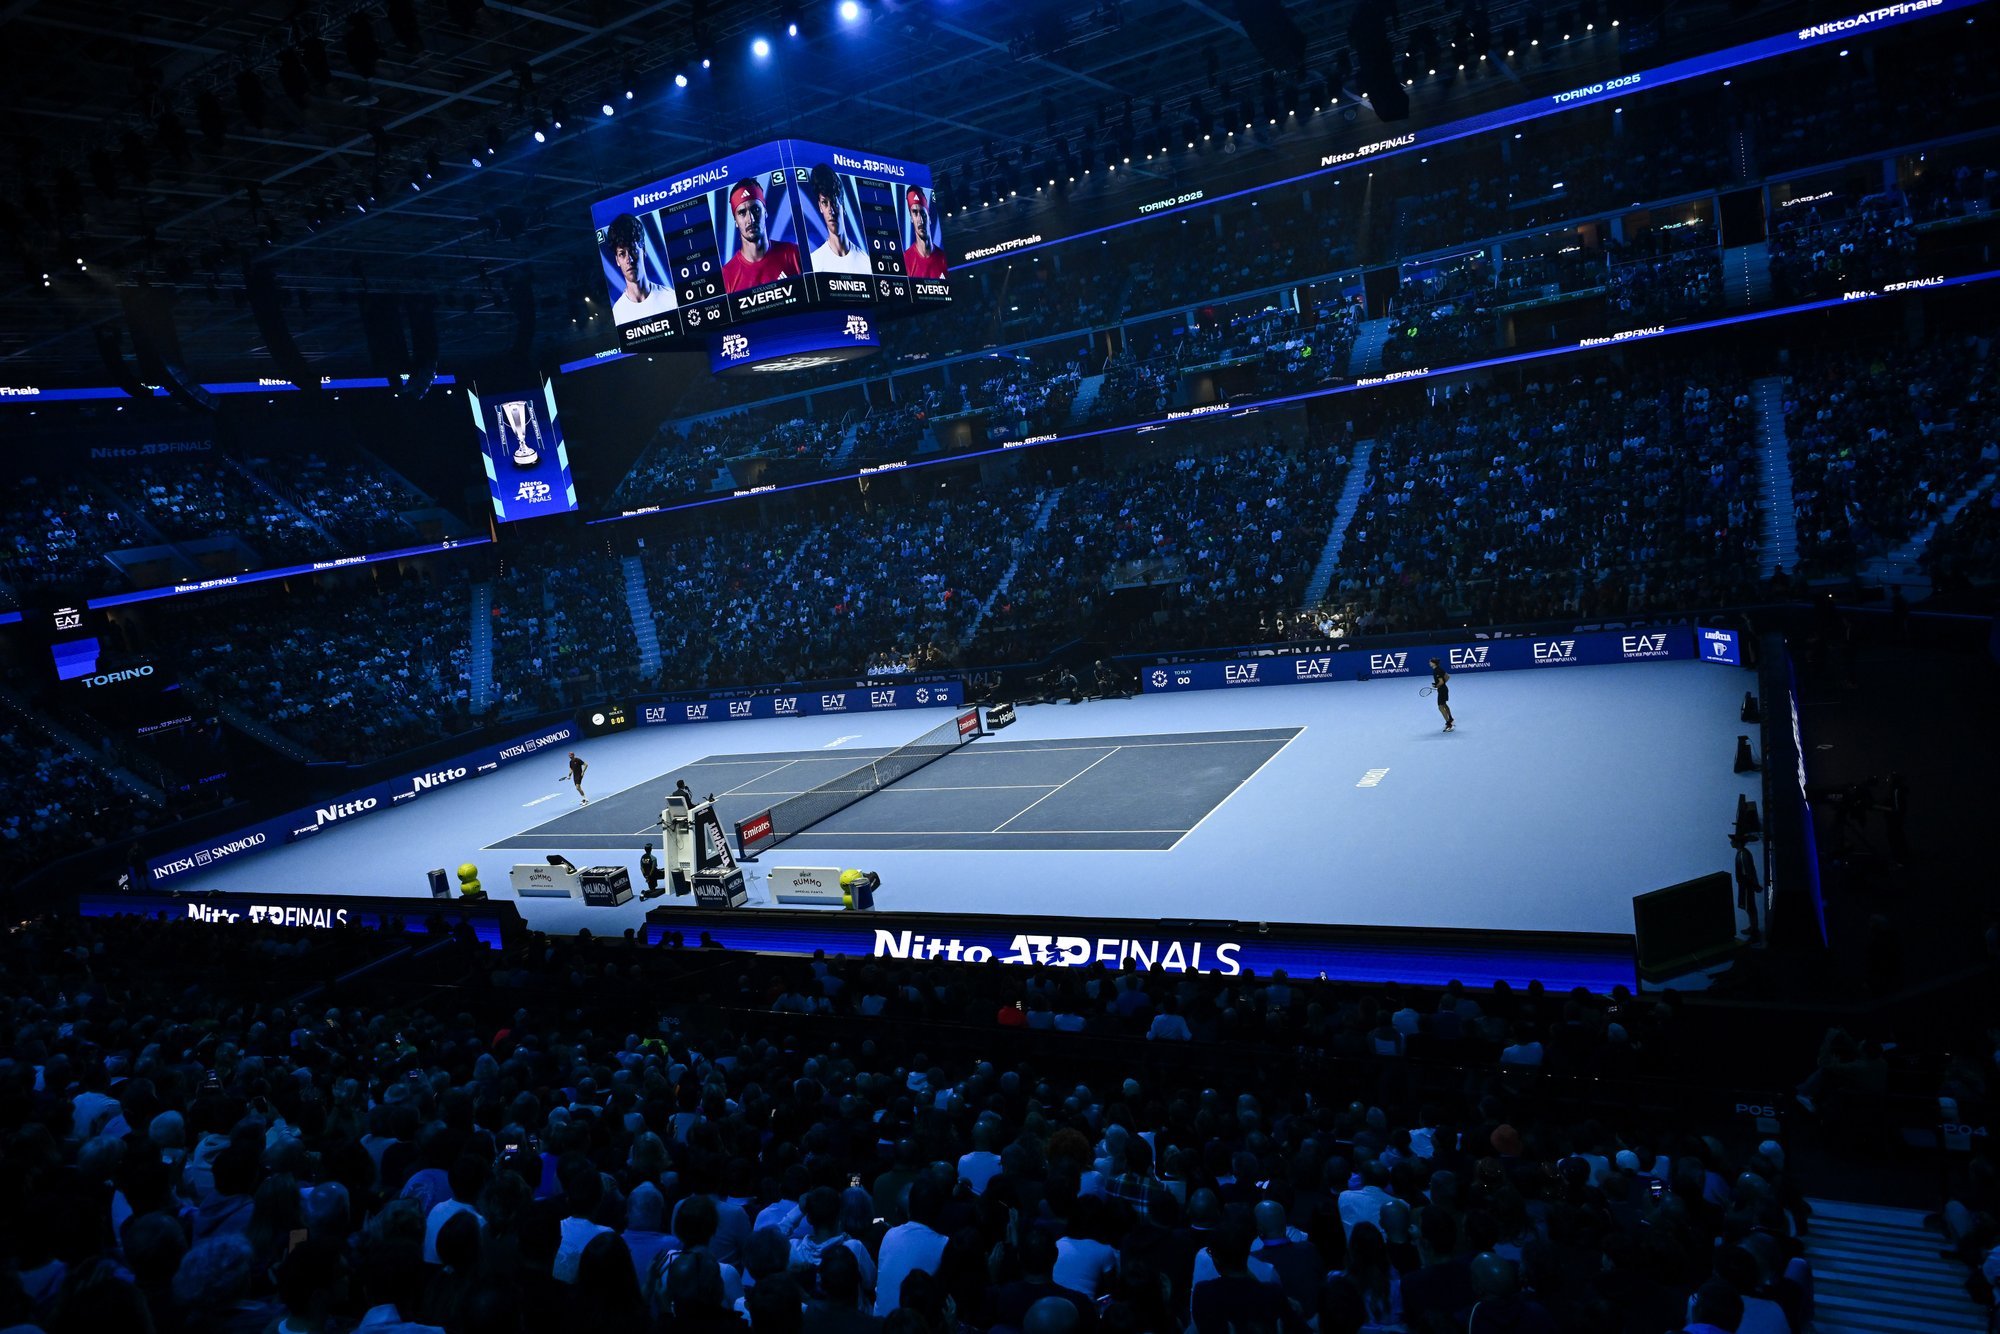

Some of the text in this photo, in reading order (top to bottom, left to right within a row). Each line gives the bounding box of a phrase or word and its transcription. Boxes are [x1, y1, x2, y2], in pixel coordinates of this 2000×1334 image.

[1798, 0, 1943, 40] #NittoATPFinals
[1552, 74, 1641, 104] TORINO 2025
[833, 153, 861, 169] Nitto
[1321, 153, 1355, 166] Nitto
[773, 171, 784, 183] 3
[797, 170, 806, 180] 2
[633, 191, 667, 208] Nitto
[692, 165, 728, 189] FINALS
[1139, 191, 1203, 213] TORINO 2025
[874, 239, 896, 251] 0 0
[965, 234, 1041, 260] #NittoATPFinals
[681, 261, 711, 278] 0 0
[878, 261, 899, 272] 0 0
[685, 284, 715, 300] 0 0
[829, 279, 866, 292] SINNER
[894, 286, 904, 296] 00
[915, 284, 950, 295] ZVEREV
[738, 285, 792, 309] ZVEREV
[1843, 290, 1877, 300] Nit
[707, 309, 721, 320] 00
[625, 319, 670, 340] SINNER
[723, 333, 740, 342] Nitto
[1580, 337, 1610, 347] Nitto
[595, 349, 617, 359] TORINO
[259, 378, 286, 386] Nitto
[1357, 378, 1382, 386] Nitto
[1167, 410, 1190, 419] Nitto
[1003, 440, 1023, 449] Nitto
[91, 447, 138, 459] Nitto
[529, 494, 552, 504] FINALS
[313, 561, 333, 569] Nitto
[175, 584, 199, 593] Nitto
[55, 614, 80, 627] EA7
[1534, 640, 1575, 659] EA7
[1622, 634, 1667, 652] EA7
[1370, 652, 1408, 669] EA7
[1450, 647, 1489, 664] EA7
[1225, 663, 1259, 680] EA7
[1296, 658, 1331, 674] EA7
[82, 665, 154, 688] TORINO
[1177, 677, 1191, 685] 00
[822, 694, 845, 708] EA7
[871, 690, 895, 704] EA7
[687, 704, 707, 717] EA7
[729, 701, 751, 714] EA7
[774, 698, 797, 711] EA7
[646, 707, 665, 720] EA7
[959, 716, 977, 731] Emirates
[500, 729, 570, 760] INTESA SANPAOLO
[412, 767, 467, 792] Nitto
[315, 797, 377, 826] Nitto
[743, 820, 770, 839] Emirates
[153, 832, 266, 880] INTESA SANPAOLO
[530, 874, 552, 882] RUMMO
[793, 878, 822, 888] RUMMO
[583, 883, 611, 894] VALMORA
[696, 884, 727, 897] VALMORA
[285, 907, 348, 928] FINALS
[874, 929, 1241, 976] Nitto ATP FINALS
[1735, 1103, 1776, 1117] P05
[1943, 1123, 1989, 1136] P04
